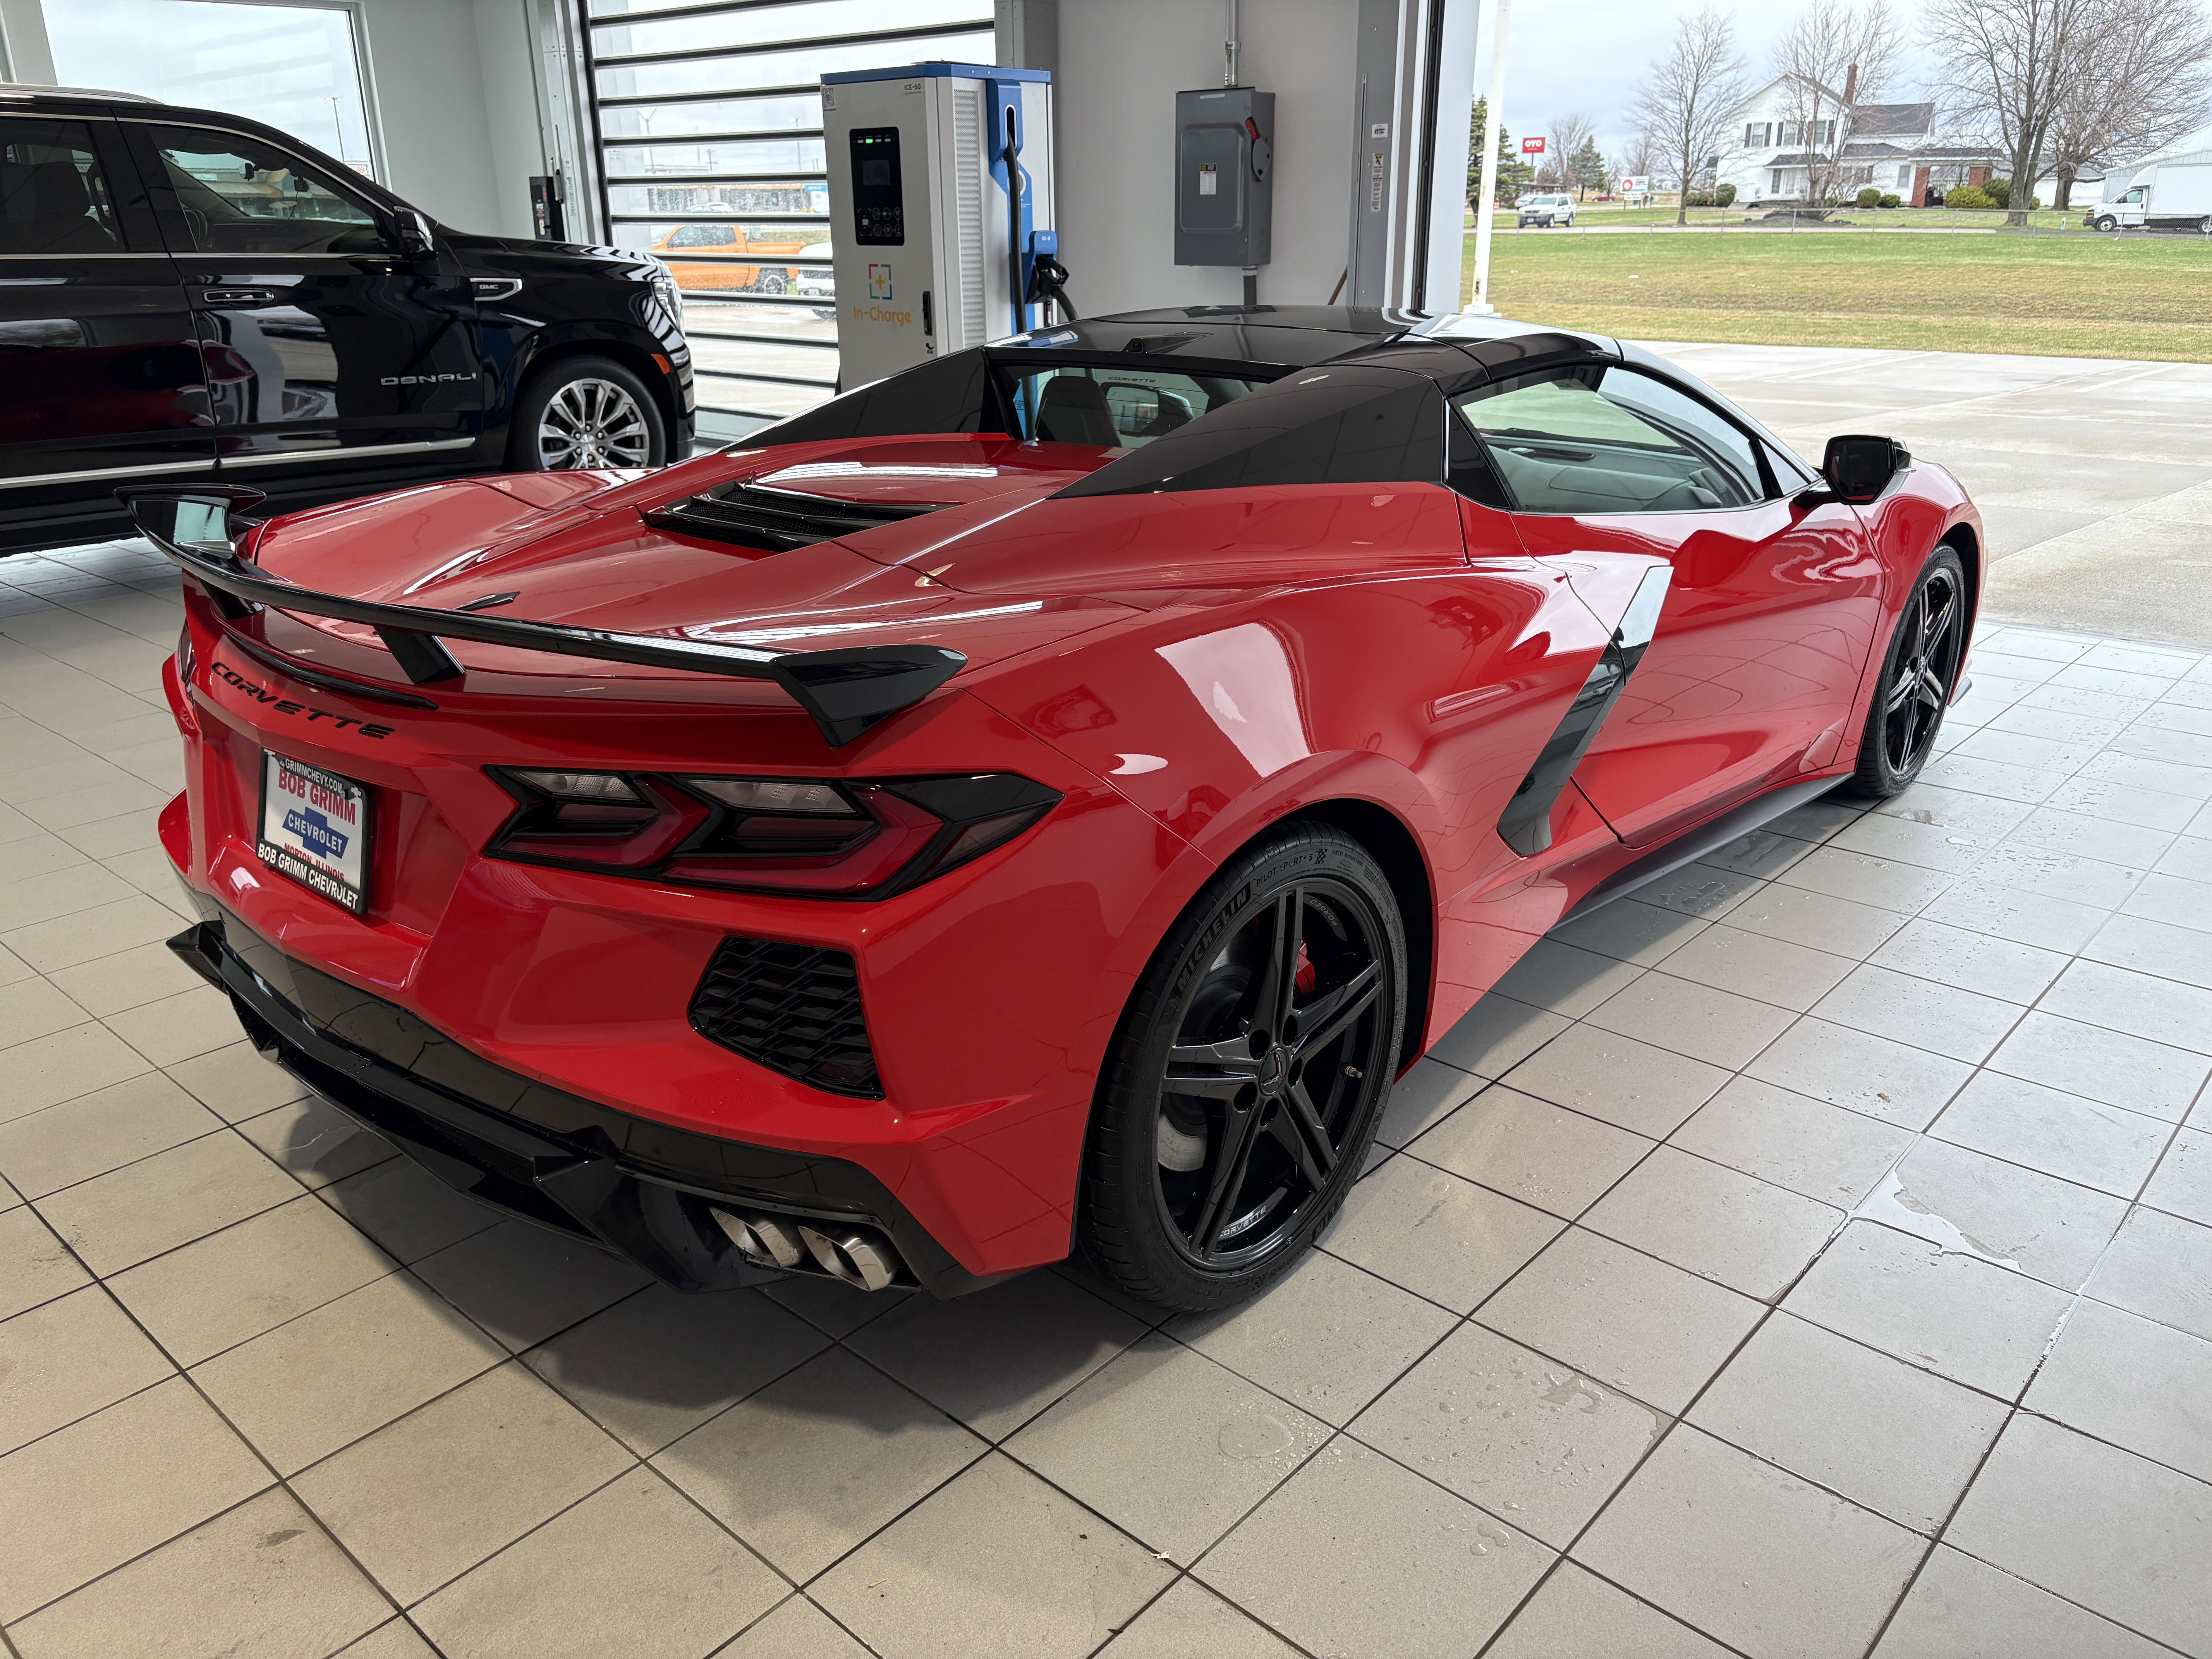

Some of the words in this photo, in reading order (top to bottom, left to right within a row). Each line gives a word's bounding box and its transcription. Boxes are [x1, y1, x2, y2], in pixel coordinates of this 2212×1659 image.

[853, 306, 911, 326] In-Charge
[381, 372, 476, 385] DENALI
[210, 661, 395, 739] CORVETTE
[285, 758, 343, 793] GRIMMCHEVY.COM
[279, 769, 306, 799] BOB
[310, 783, 356, 825] GRIMM
[288, 814, 342, 853] CHEVROLET
[258, 843, 277, 864] BOB
[278, 853, 307, 881] GRIMM
[309, 869, 358, 909] CHEVROLET
[1256, 867, 1277, 887] PILOT
[1310, 899, 1339, 926] FORGED
[1177, 888, 1247, 993] MICHELIN
